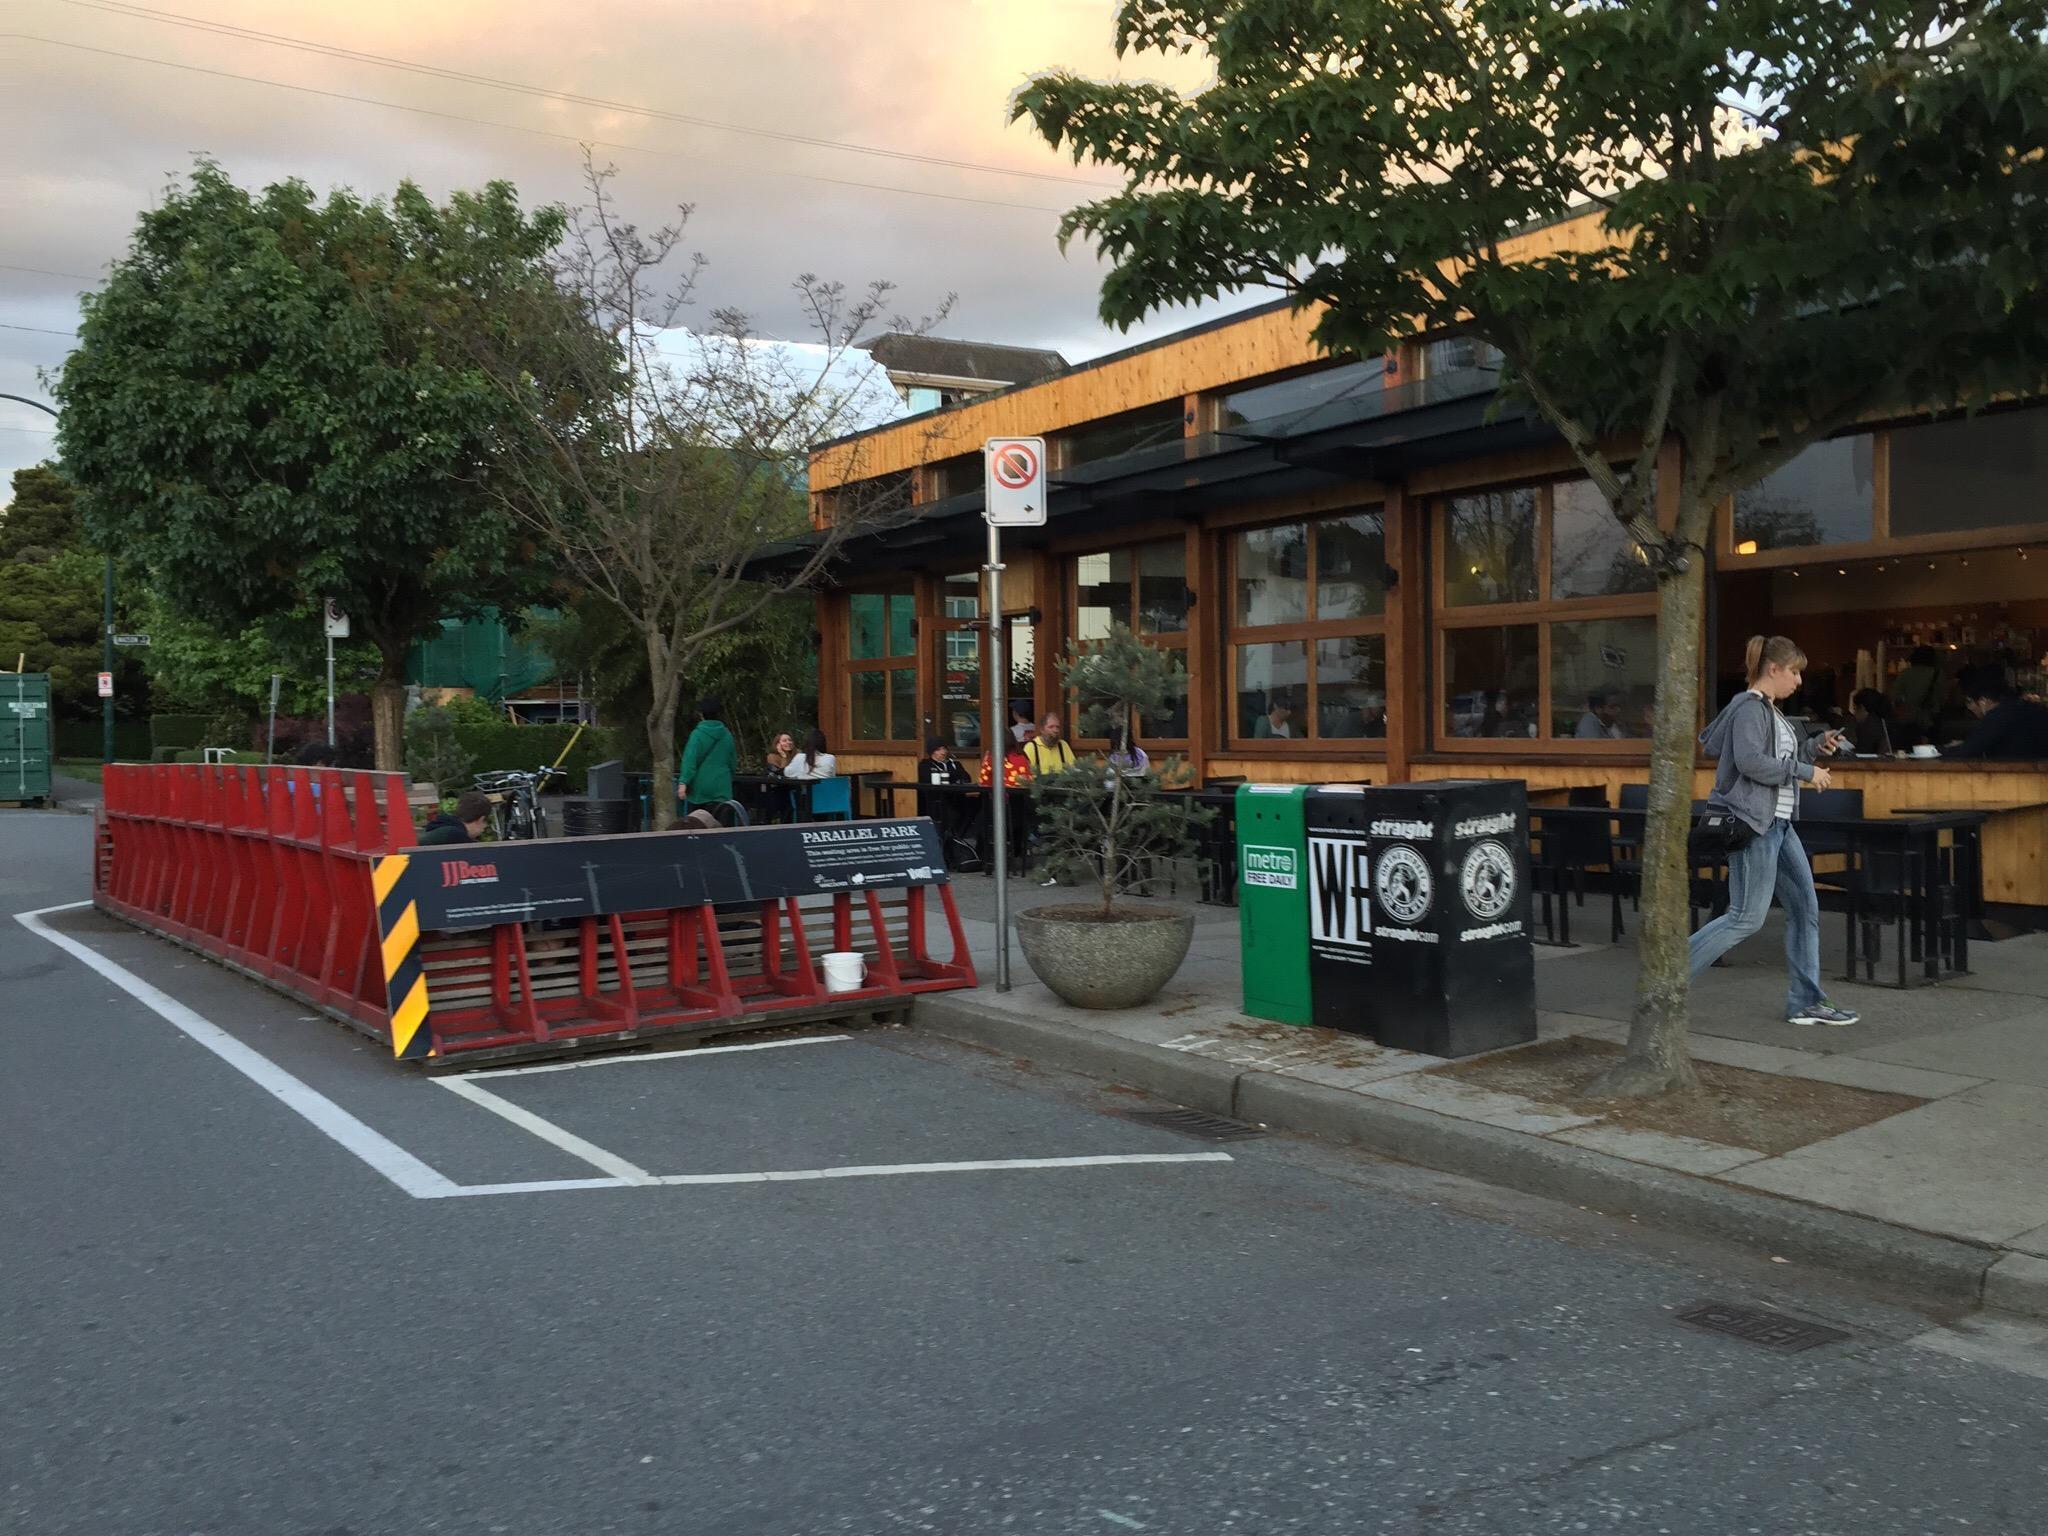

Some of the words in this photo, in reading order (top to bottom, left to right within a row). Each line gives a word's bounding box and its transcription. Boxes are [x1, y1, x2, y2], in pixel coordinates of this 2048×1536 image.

[1370, 821, 1433, 839] straight
[1455, 813, 1516, 835] straight
[801, 828, 878, 843] PARALLEL
[880, 826, 920, 837] PARK
[1247, 852, 1292, 871] metro
[1247, 872, 1267, 884] FREE
[1269, 874, 1294, 886] DAILY
